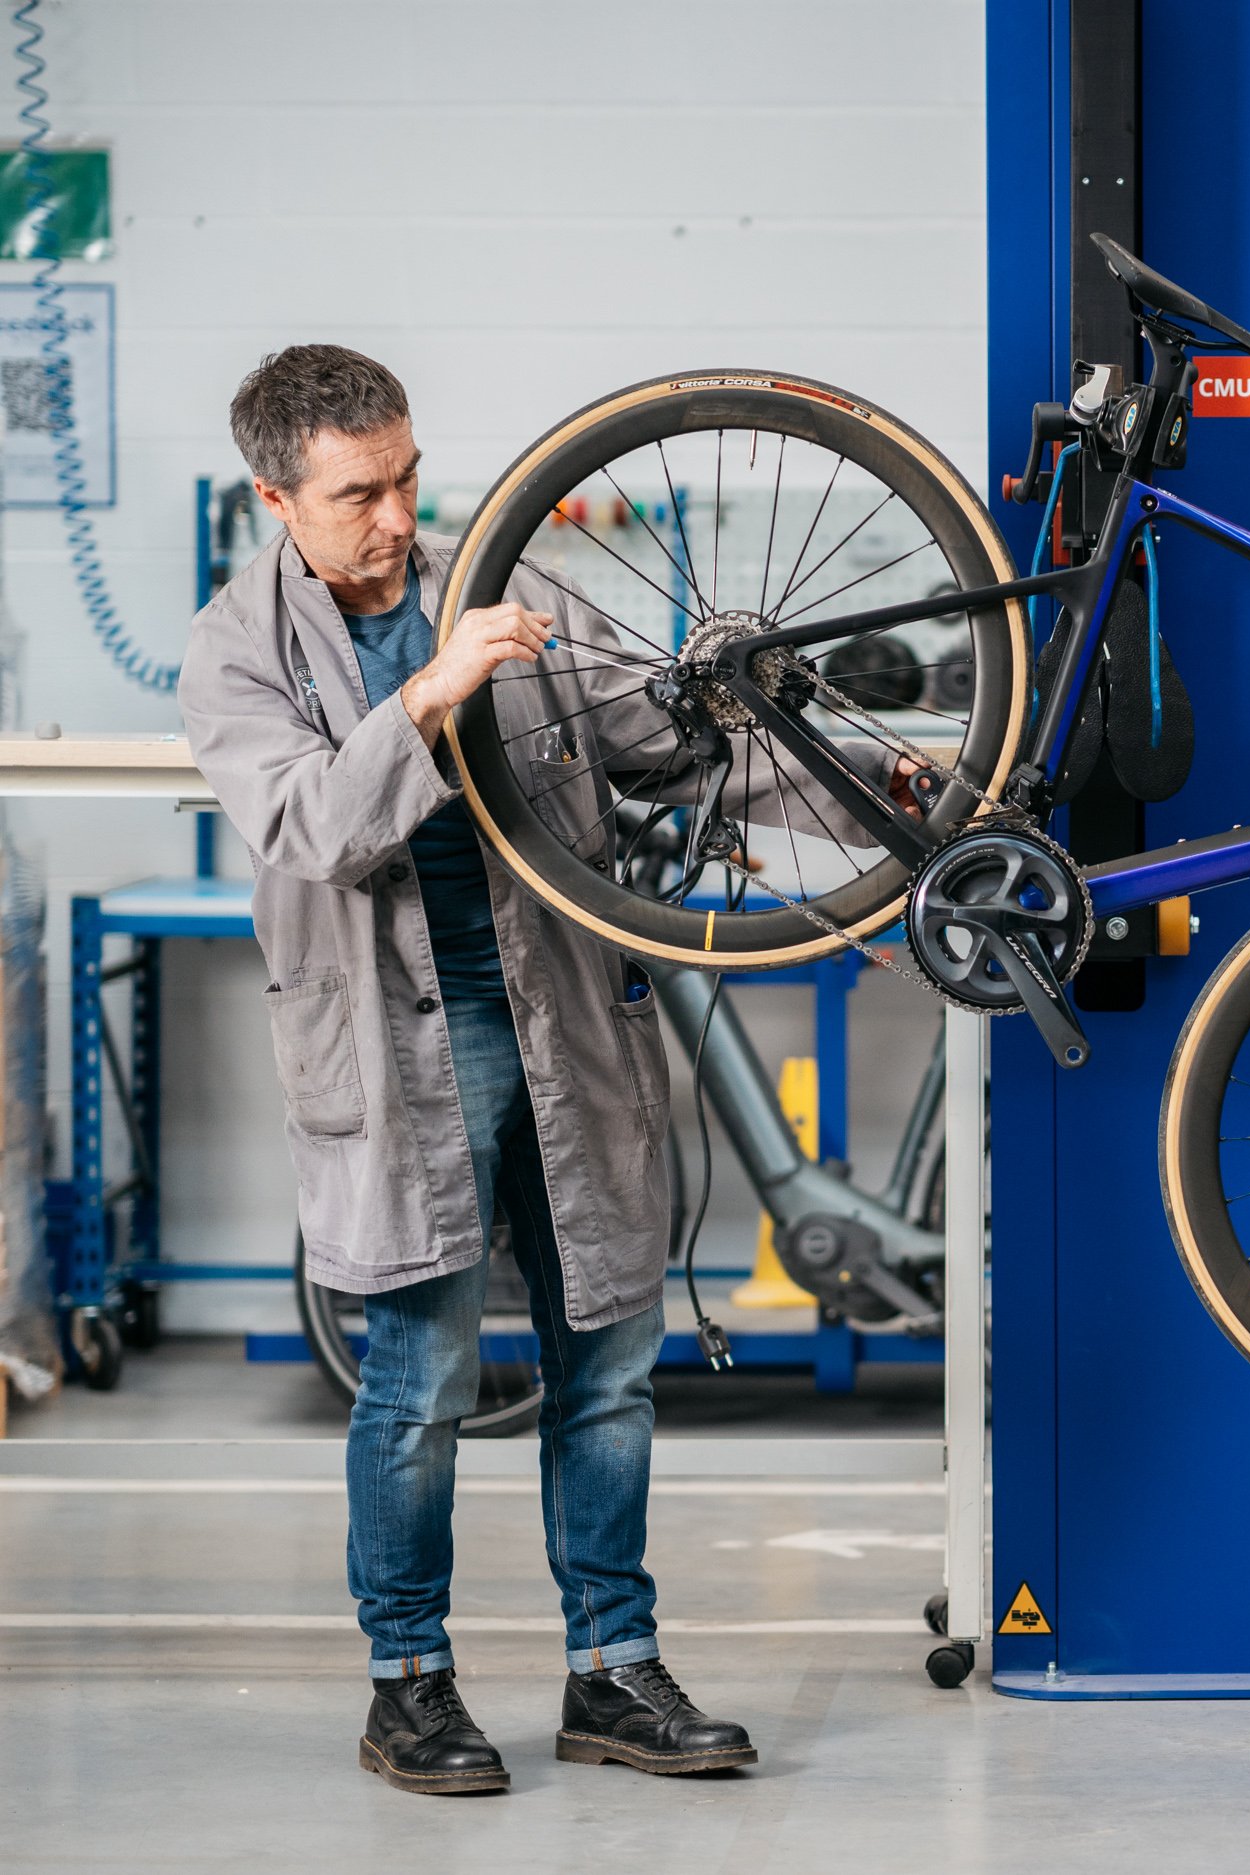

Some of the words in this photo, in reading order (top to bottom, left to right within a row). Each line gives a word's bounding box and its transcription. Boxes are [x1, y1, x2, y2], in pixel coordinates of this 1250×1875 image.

[679, 379, 720, 388] vittoria
[724, 379, 771, 388] CORSA
[1006, 936, 1058, 999] ULTEGRA
